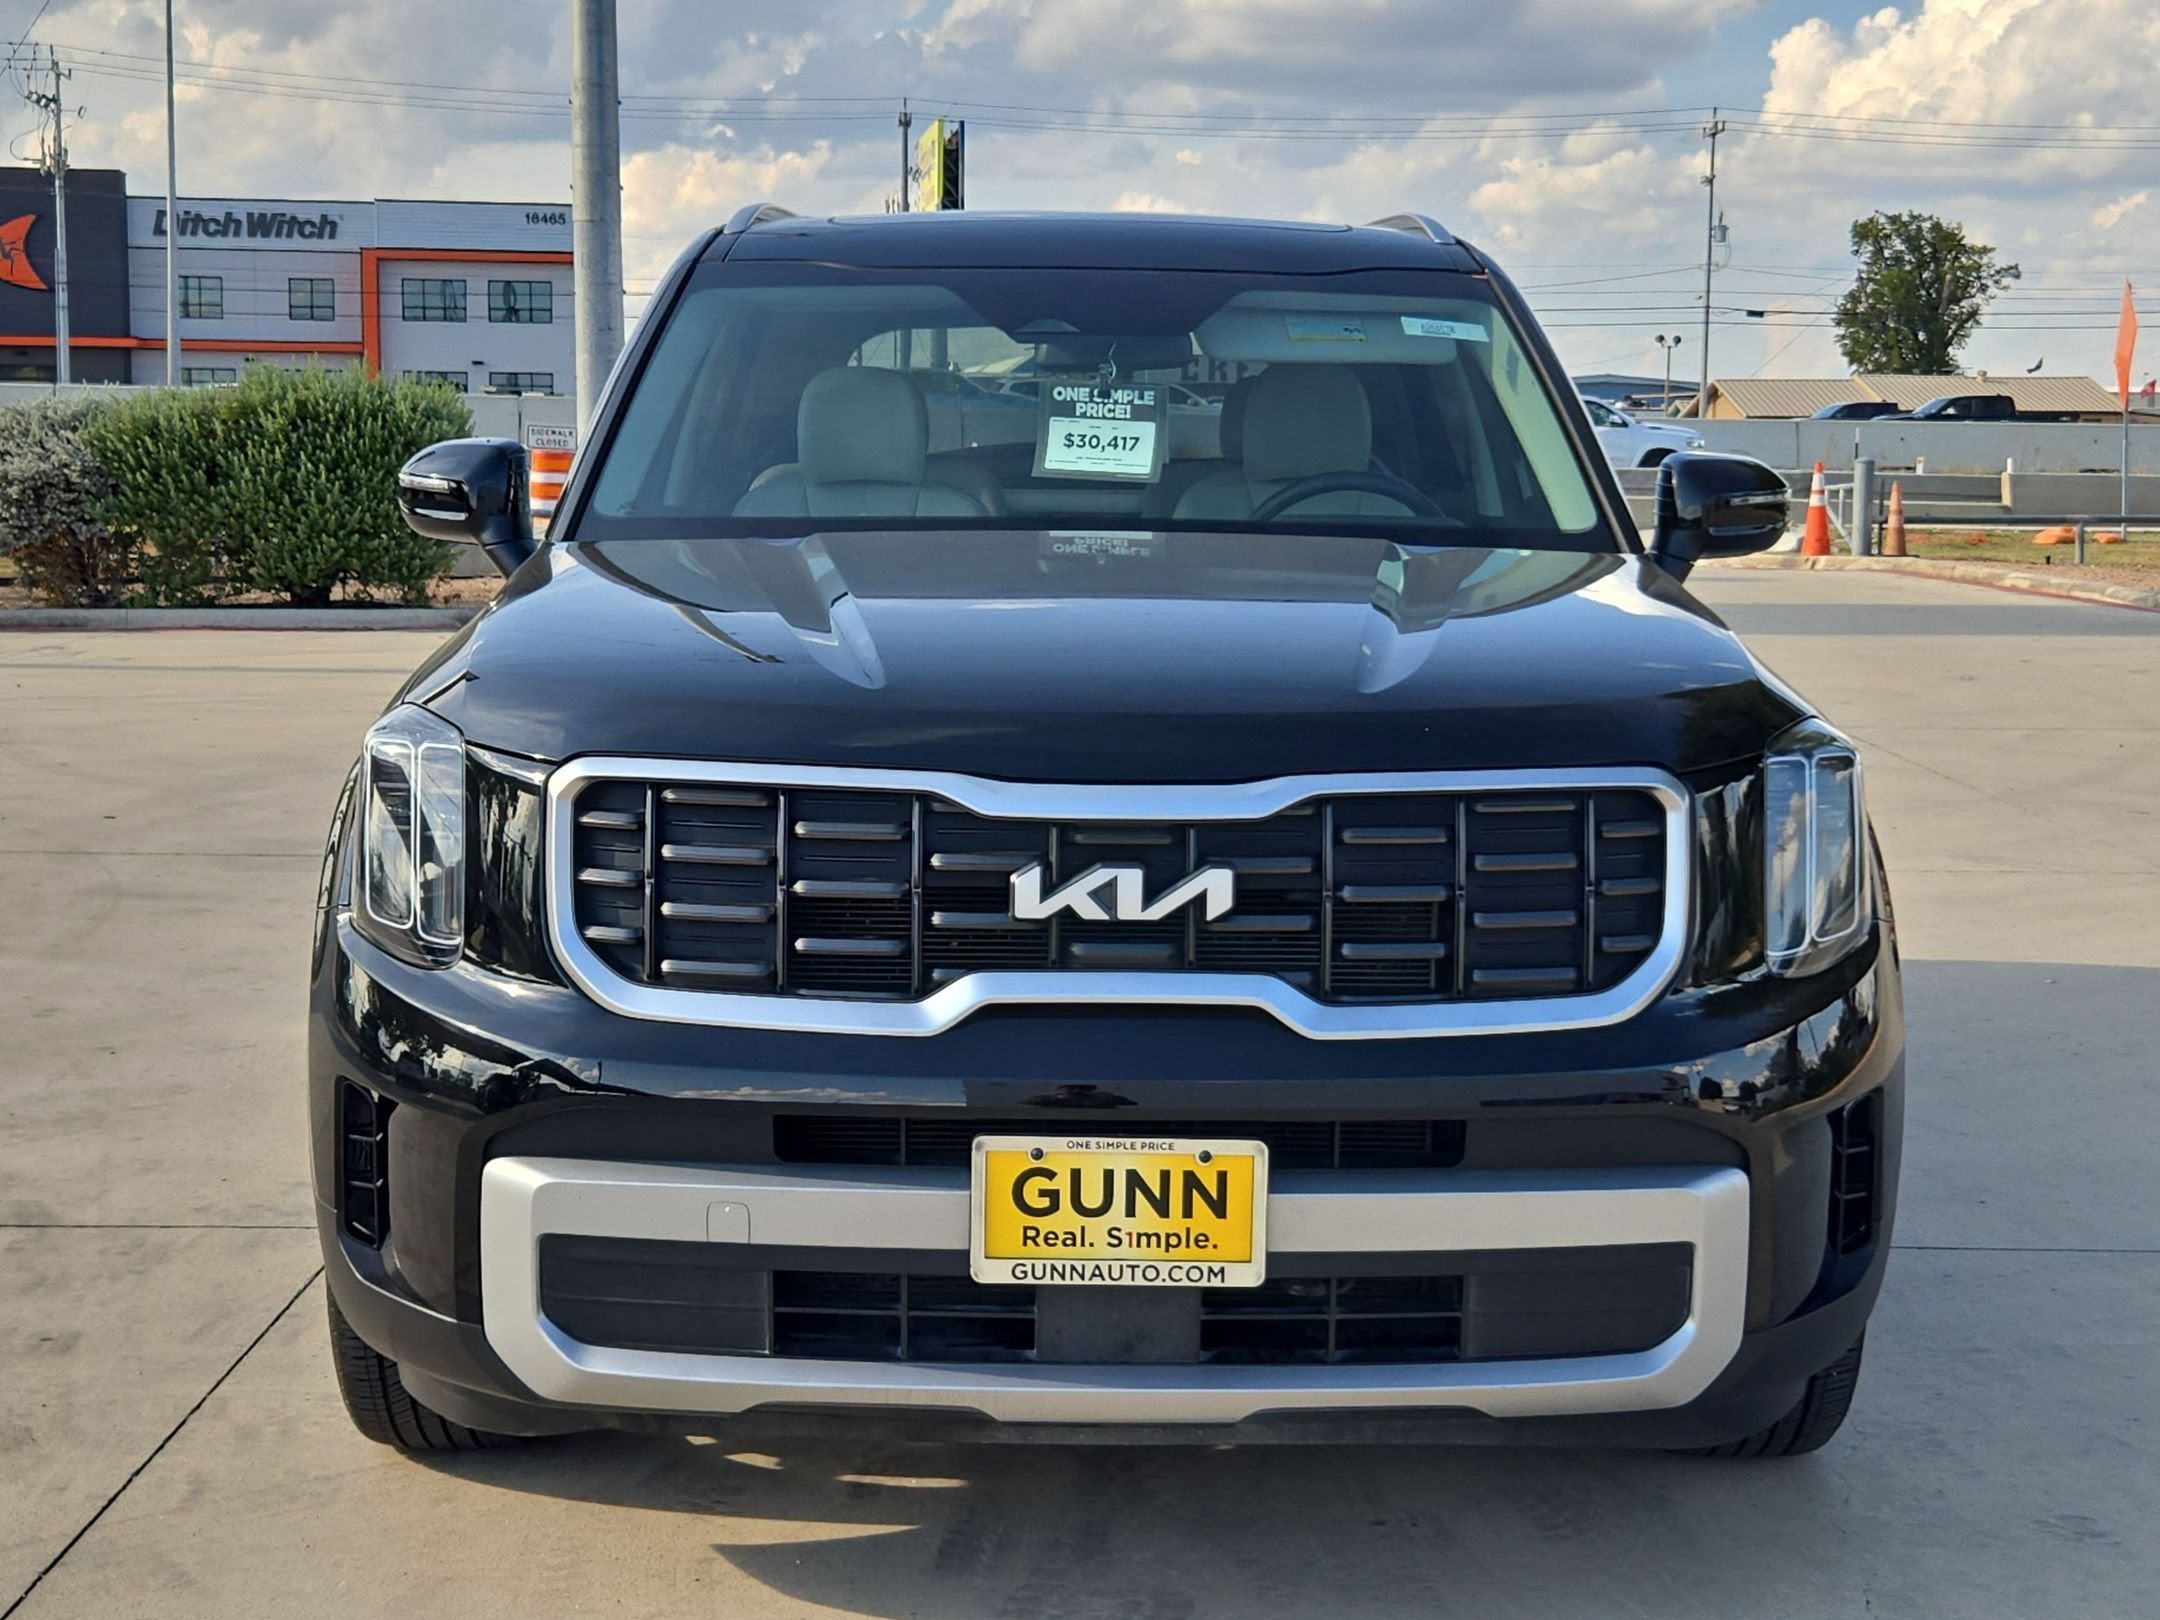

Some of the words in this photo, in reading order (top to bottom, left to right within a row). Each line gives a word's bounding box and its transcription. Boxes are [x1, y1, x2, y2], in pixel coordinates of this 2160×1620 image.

[153, 209, 242, 237] Ditch
[246, 212, 338, 239] Witch
[525, 212, 566, 225] 16465
[1052, 386, 1090, 402] ONE
[1093, 388, 1155, 405] SMPLE
[1075, 402, 1131, 418] PRICE!
[531, 428, 574, 438] SIDEWALK
[535, 438, 569, 447] CLOSED
[1063, 432, 1140, 453] $30,417
[1066, 1140, 1092, 1150] ONE
[1095, 1141, 1137, 1151] SIMPLE
[1141, 1142, 1175, 1151] PRICE
[1011, 1167, 1228, 1219] GUNN
[1022, 1226, 1094, 1248] Real.
[1011, 1263, 1225, 1283] GUNNAUTO.COM
